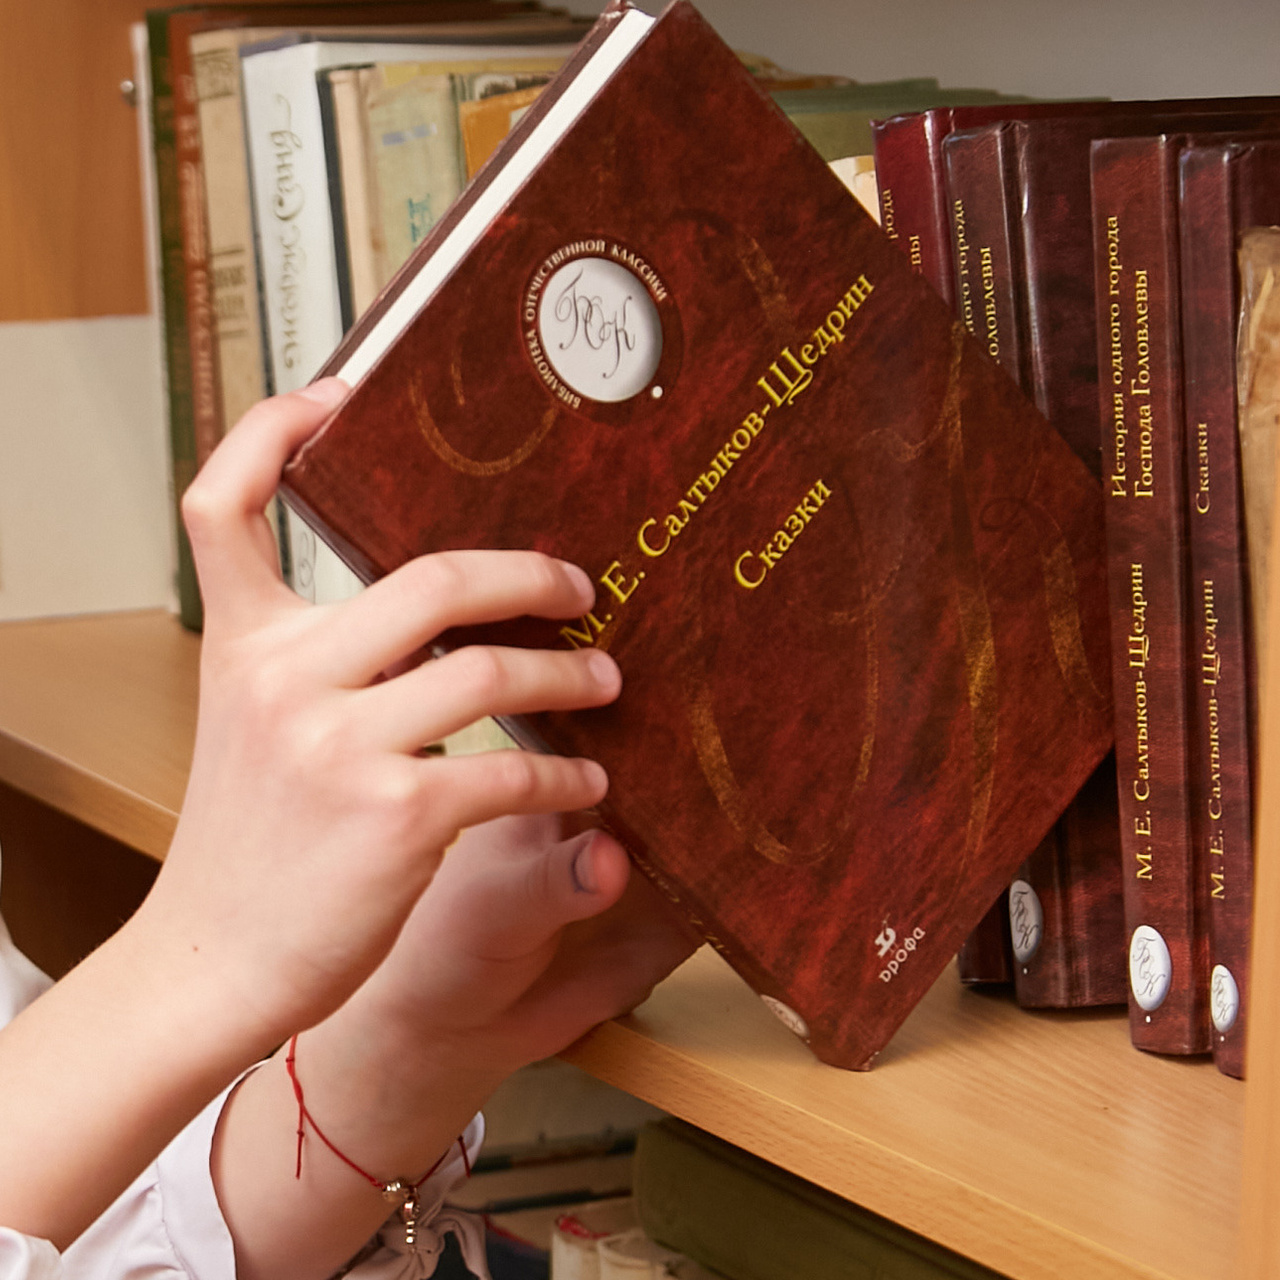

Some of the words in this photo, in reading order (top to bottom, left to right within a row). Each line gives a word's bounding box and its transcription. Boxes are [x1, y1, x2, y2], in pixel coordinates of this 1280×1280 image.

[881, 189, 898, 239] рода
[953, 199, 969, 274] города
[526, 239, 606, 321] ОТЕЧЕСТВЕННОЙ
[612, 243, 668, 302] КЛАССИКИ
[1107, 215, 1124, 296] города
[979, 246, 1000, 363] оловлевы
[1108, 303, 1125, 384] одного
[1131, 268, 1151, 397] Головлевы
[526, 328, 582, 410] БИБЛИОТЕКА
[600, 560, 646, 604] Е.
[637, 274, 875, 558] Салтыков-Щедрин
[1110, 392, 1129, 497] История
[1134, 405, 1153, 497] Господа
[1195, 422, 1210, 514] Сказки
[734, 478, 833, 590] Сказки
[1128, 562, 1151, 801] Салтыков-Щедрин
[1202, 579, 1222, 819] Салтыков-Щедрин
[1134, 810, 1151, 837] Е.
[1135, 846, 1153, 880] М.
[1208, 829, 1224, 856] Е.
[1210, 867, 1225, 899] М.
